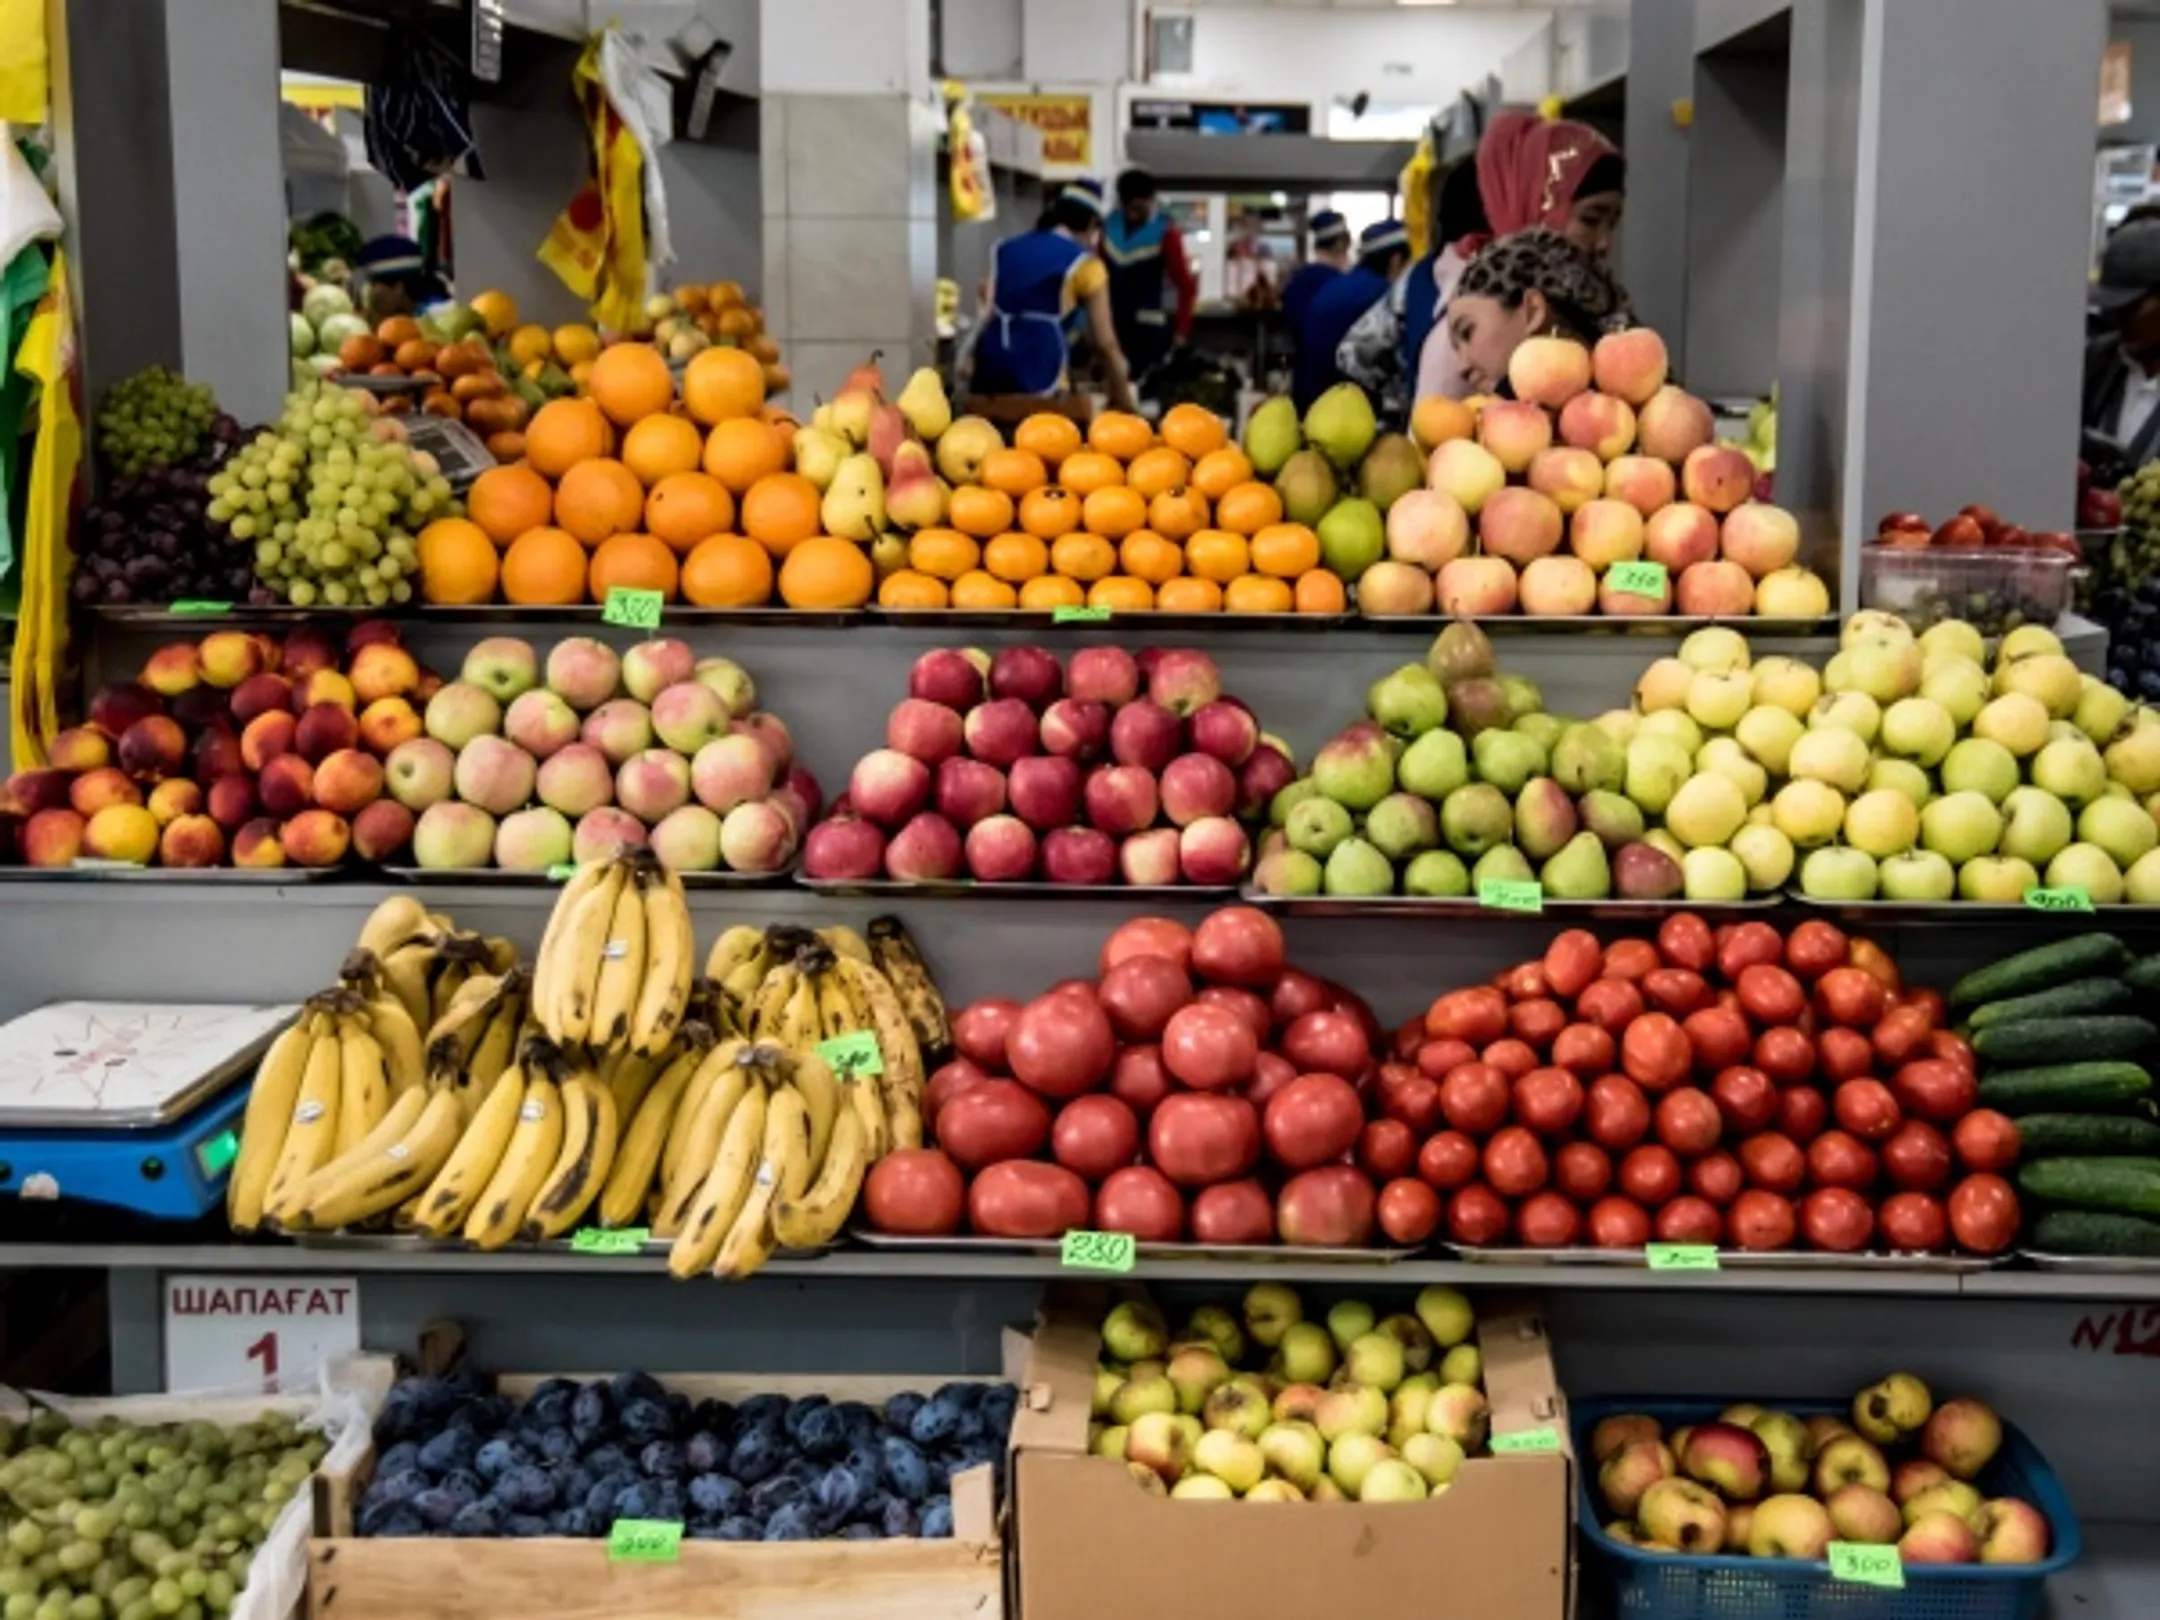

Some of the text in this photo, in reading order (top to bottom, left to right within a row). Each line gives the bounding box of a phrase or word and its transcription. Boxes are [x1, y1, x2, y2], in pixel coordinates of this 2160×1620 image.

[1069, 1234, 1128, 1265] 280
[173, 1288, 350, 1315] ШАПАҒАТ
[247, 1331, 279, 1394] 1
[1846, 1555, 1891, 1575] 300
